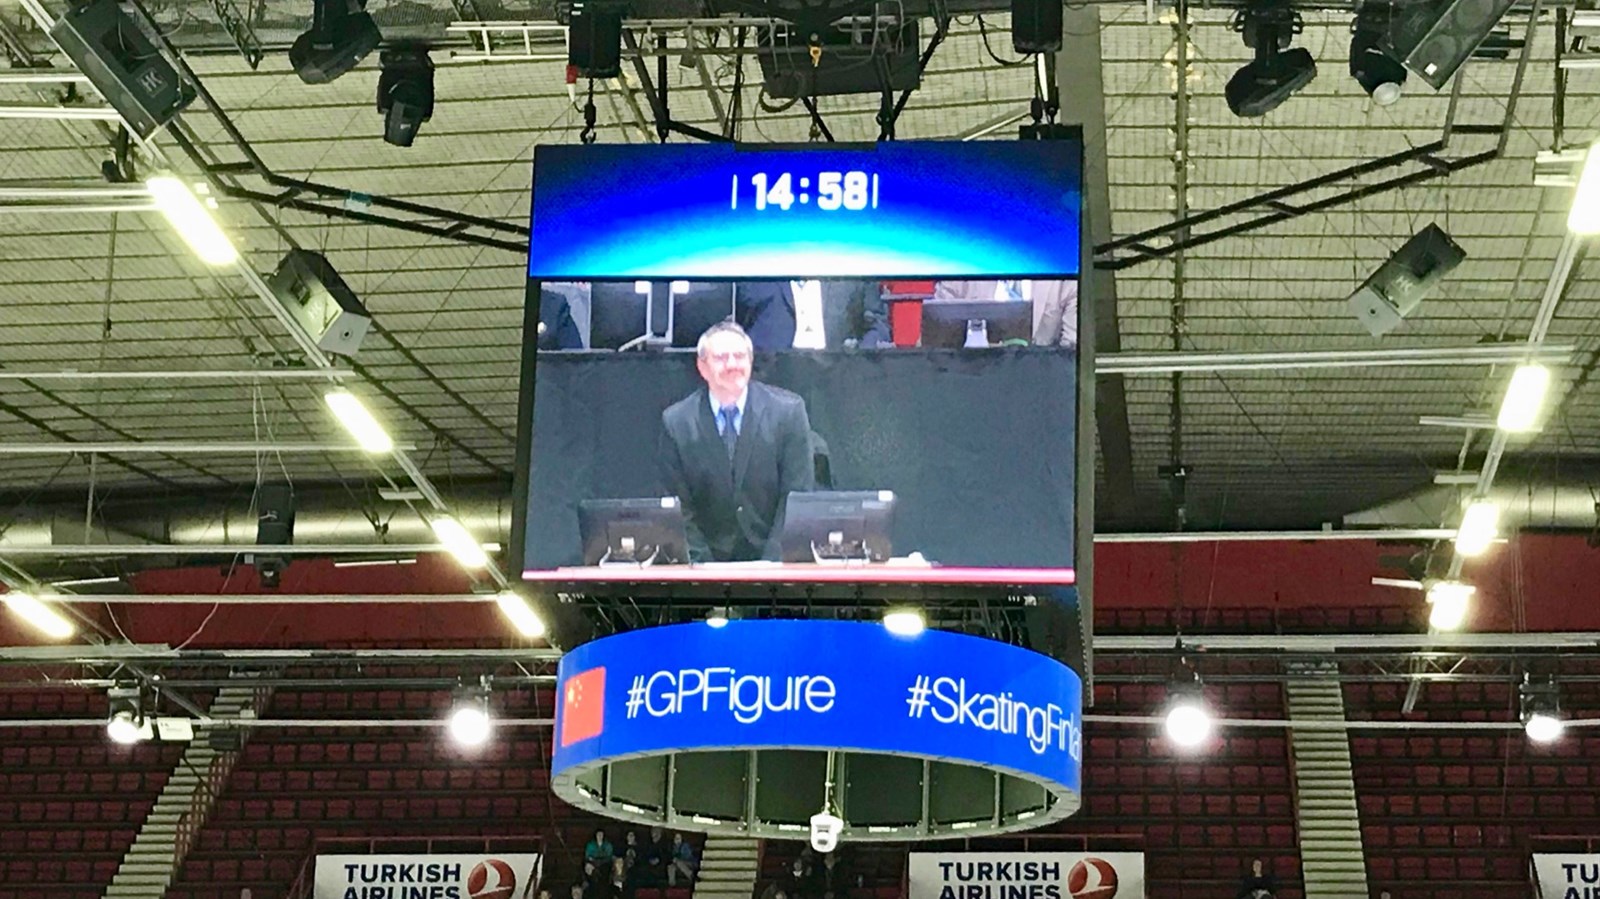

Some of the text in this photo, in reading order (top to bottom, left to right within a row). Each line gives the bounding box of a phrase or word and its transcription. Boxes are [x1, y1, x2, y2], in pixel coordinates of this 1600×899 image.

[752, 171, 867, 211] 14:58
[625, 667, 836, 724] #GPFigure
[344, 863, 461, 882] TURKISH
[939, 861, 1060, 881] TURKISH
[344, 886, 461, 899] AIRLINES
[939, 885, 1061, 899] AIRLINES
